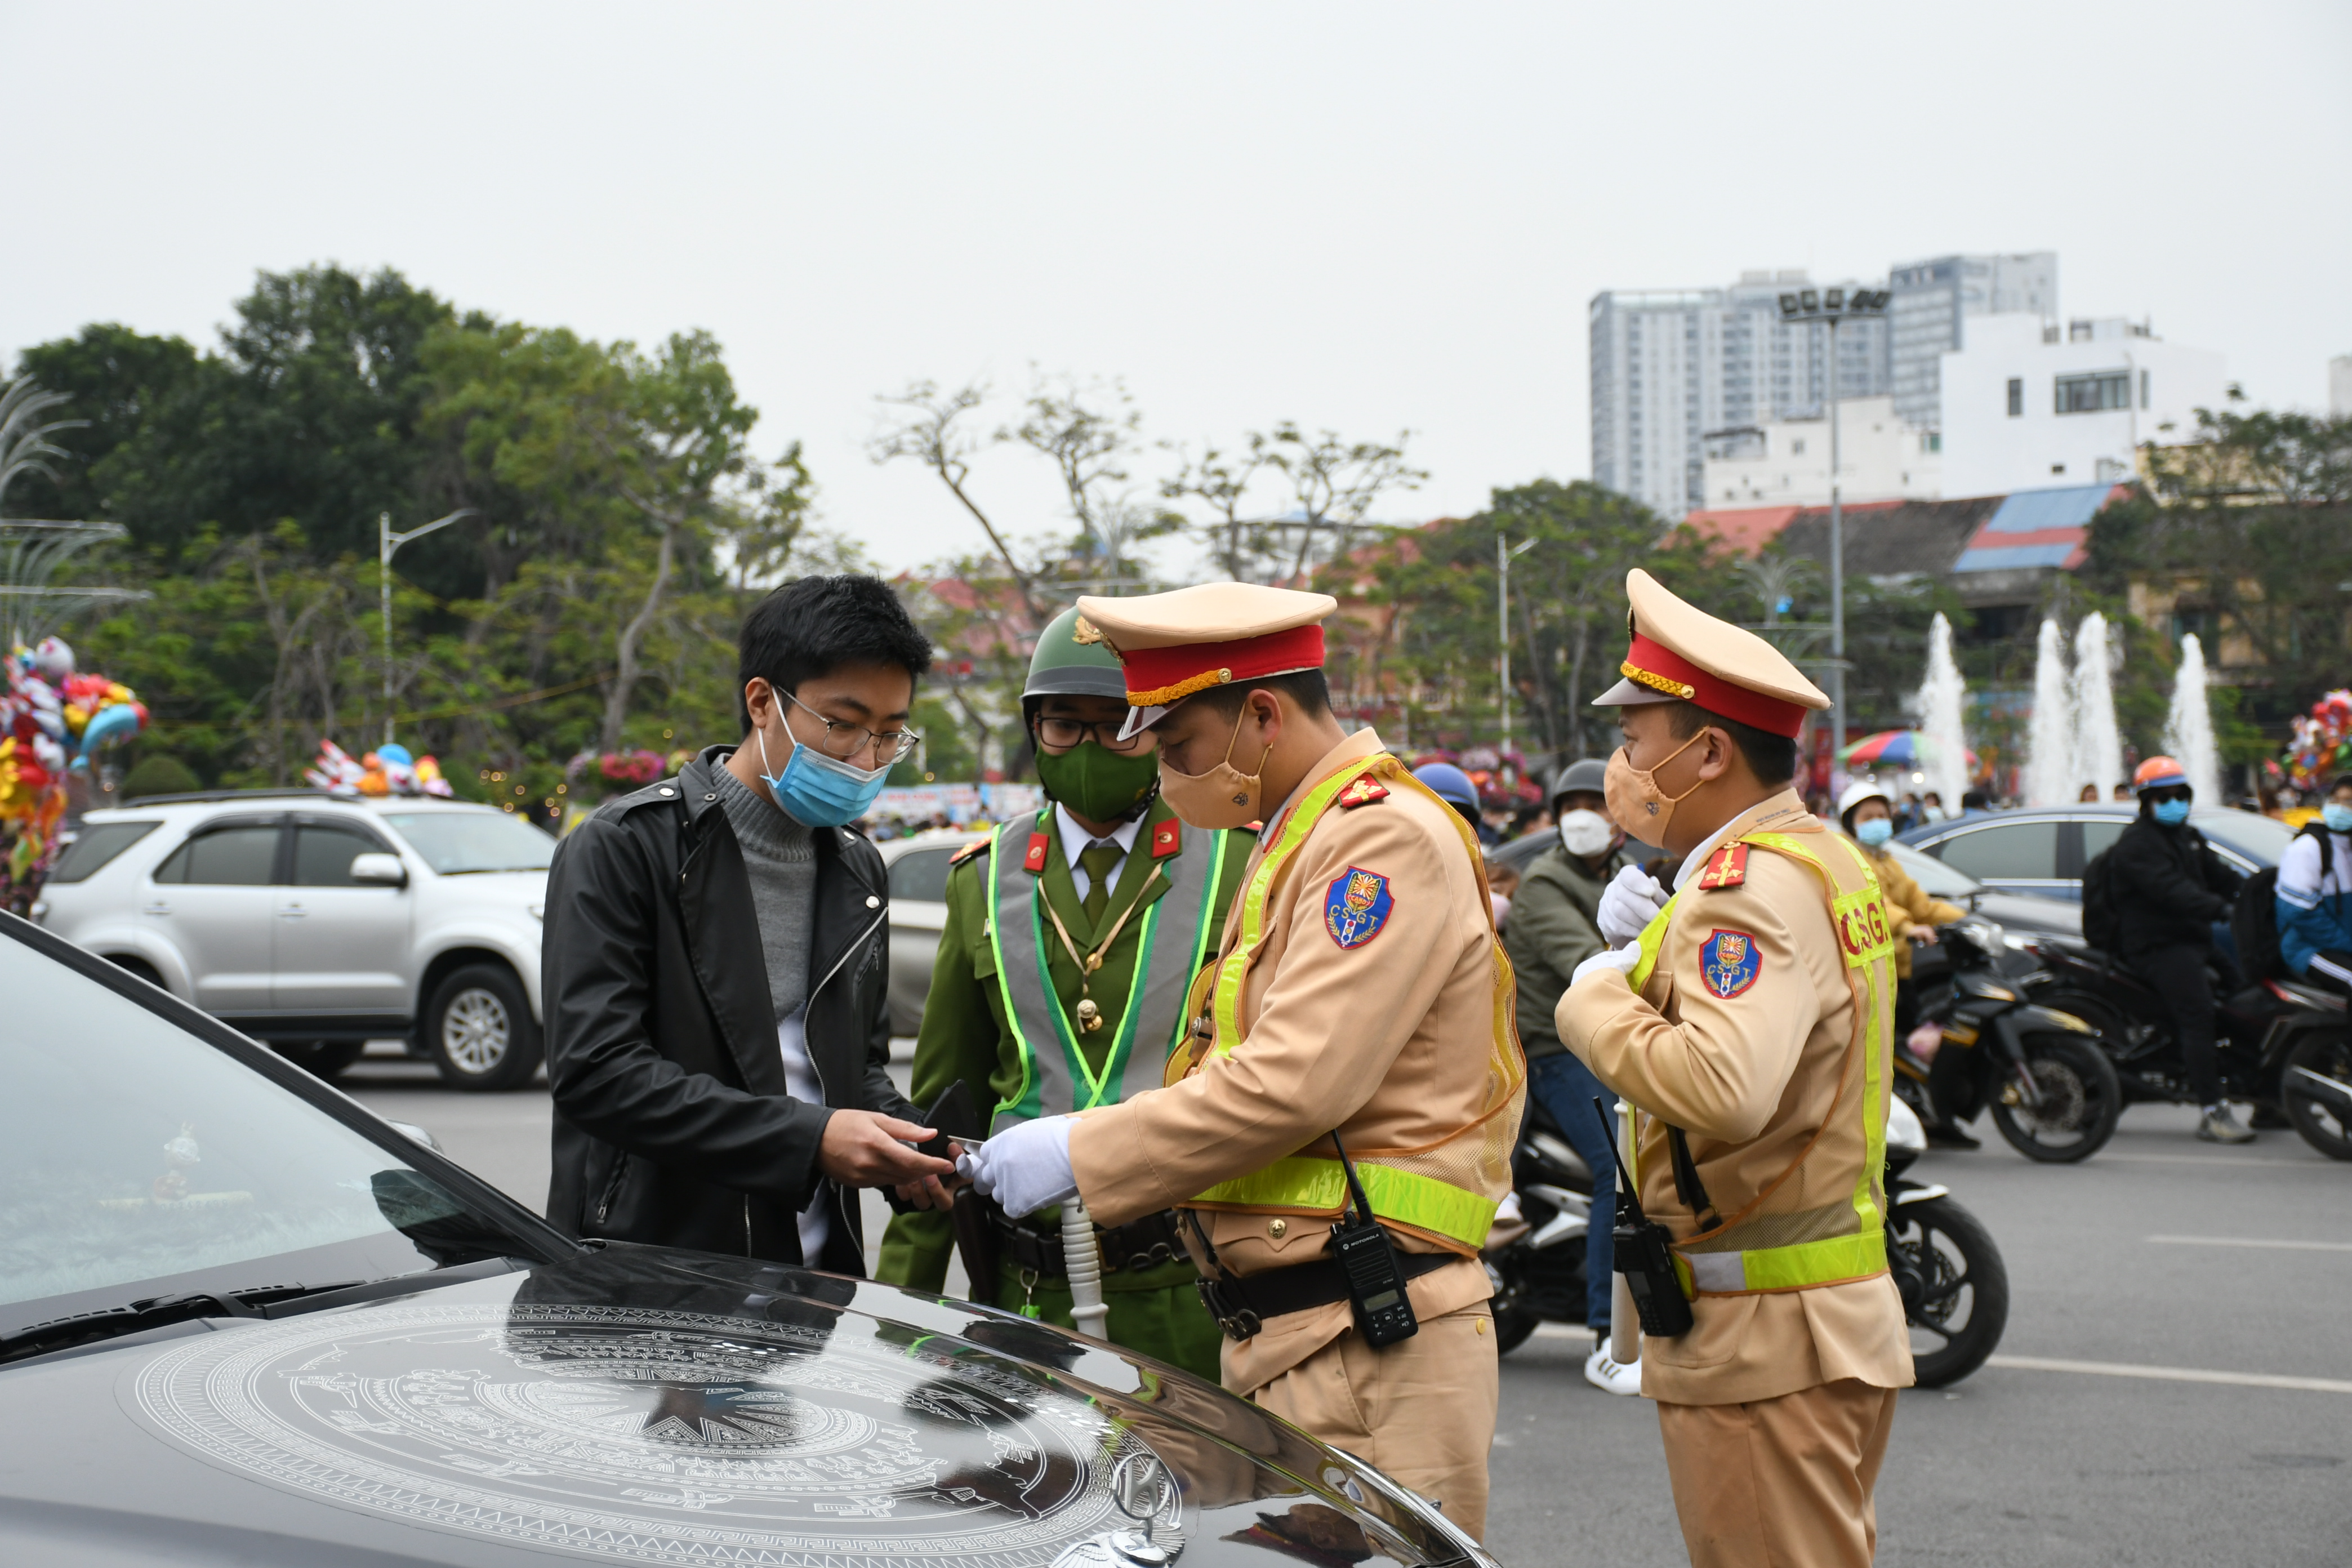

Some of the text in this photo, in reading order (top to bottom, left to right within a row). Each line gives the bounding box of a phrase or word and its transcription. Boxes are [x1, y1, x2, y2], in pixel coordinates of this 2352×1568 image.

[1330, 905, 1378, 927] CSGT
[1708, 964, 1751, 977] CSGT
[1351, 1233, 1379, 1246] MOTOROLA
